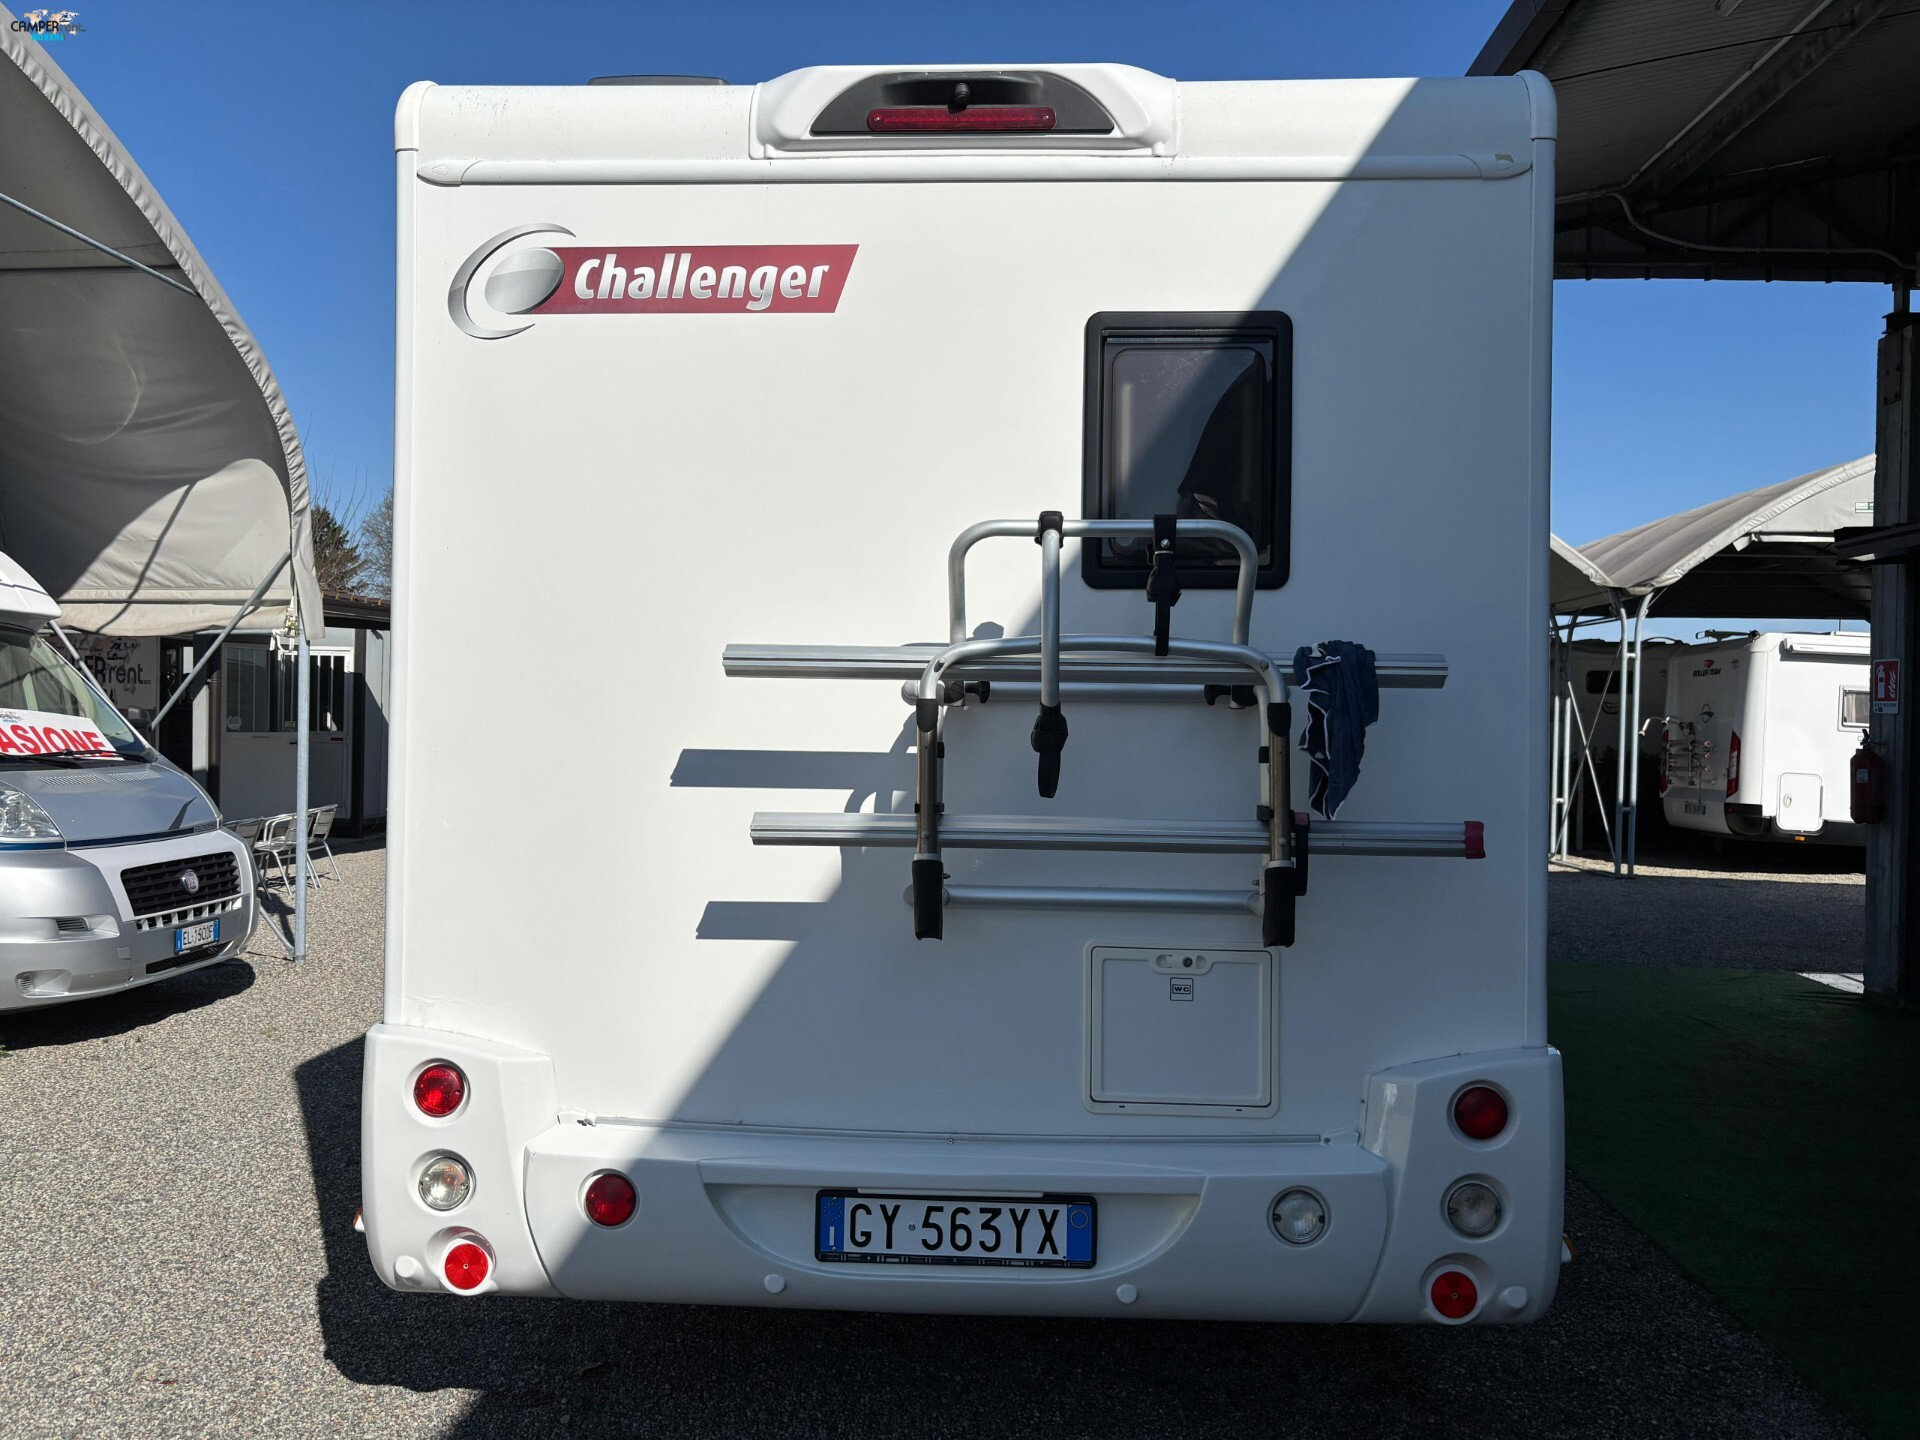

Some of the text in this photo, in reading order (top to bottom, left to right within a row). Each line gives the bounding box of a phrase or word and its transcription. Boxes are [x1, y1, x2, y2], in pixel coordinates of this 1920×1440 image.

[574, 253, 830, 311] Challenger
[850, 1203, 1060, 1255] GY 563YX
